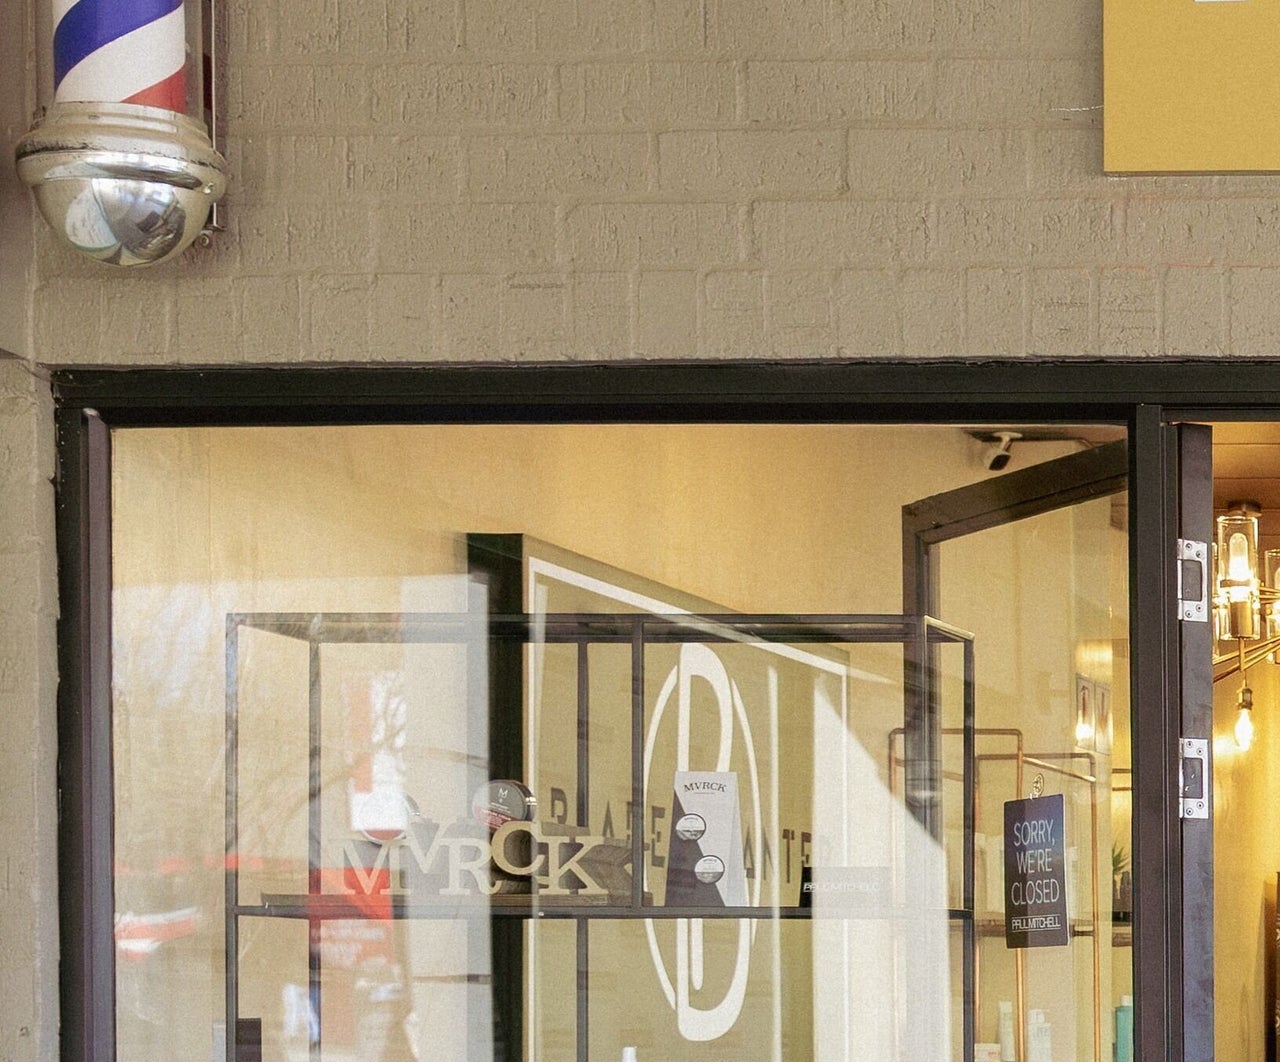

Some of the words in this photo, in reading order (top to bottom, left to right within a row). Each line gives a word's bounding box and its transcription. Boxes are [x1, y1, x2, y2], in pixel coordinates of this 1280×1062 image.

[683, 781, 727, 793] MVRCK
[1013, 818, 1056, 847] SORRY,
[332, 820, 608, 896] MVRCK
[1016, 848, 1053, 875] WE'RE
[1011, 878, 1060, 906] CLOSED
